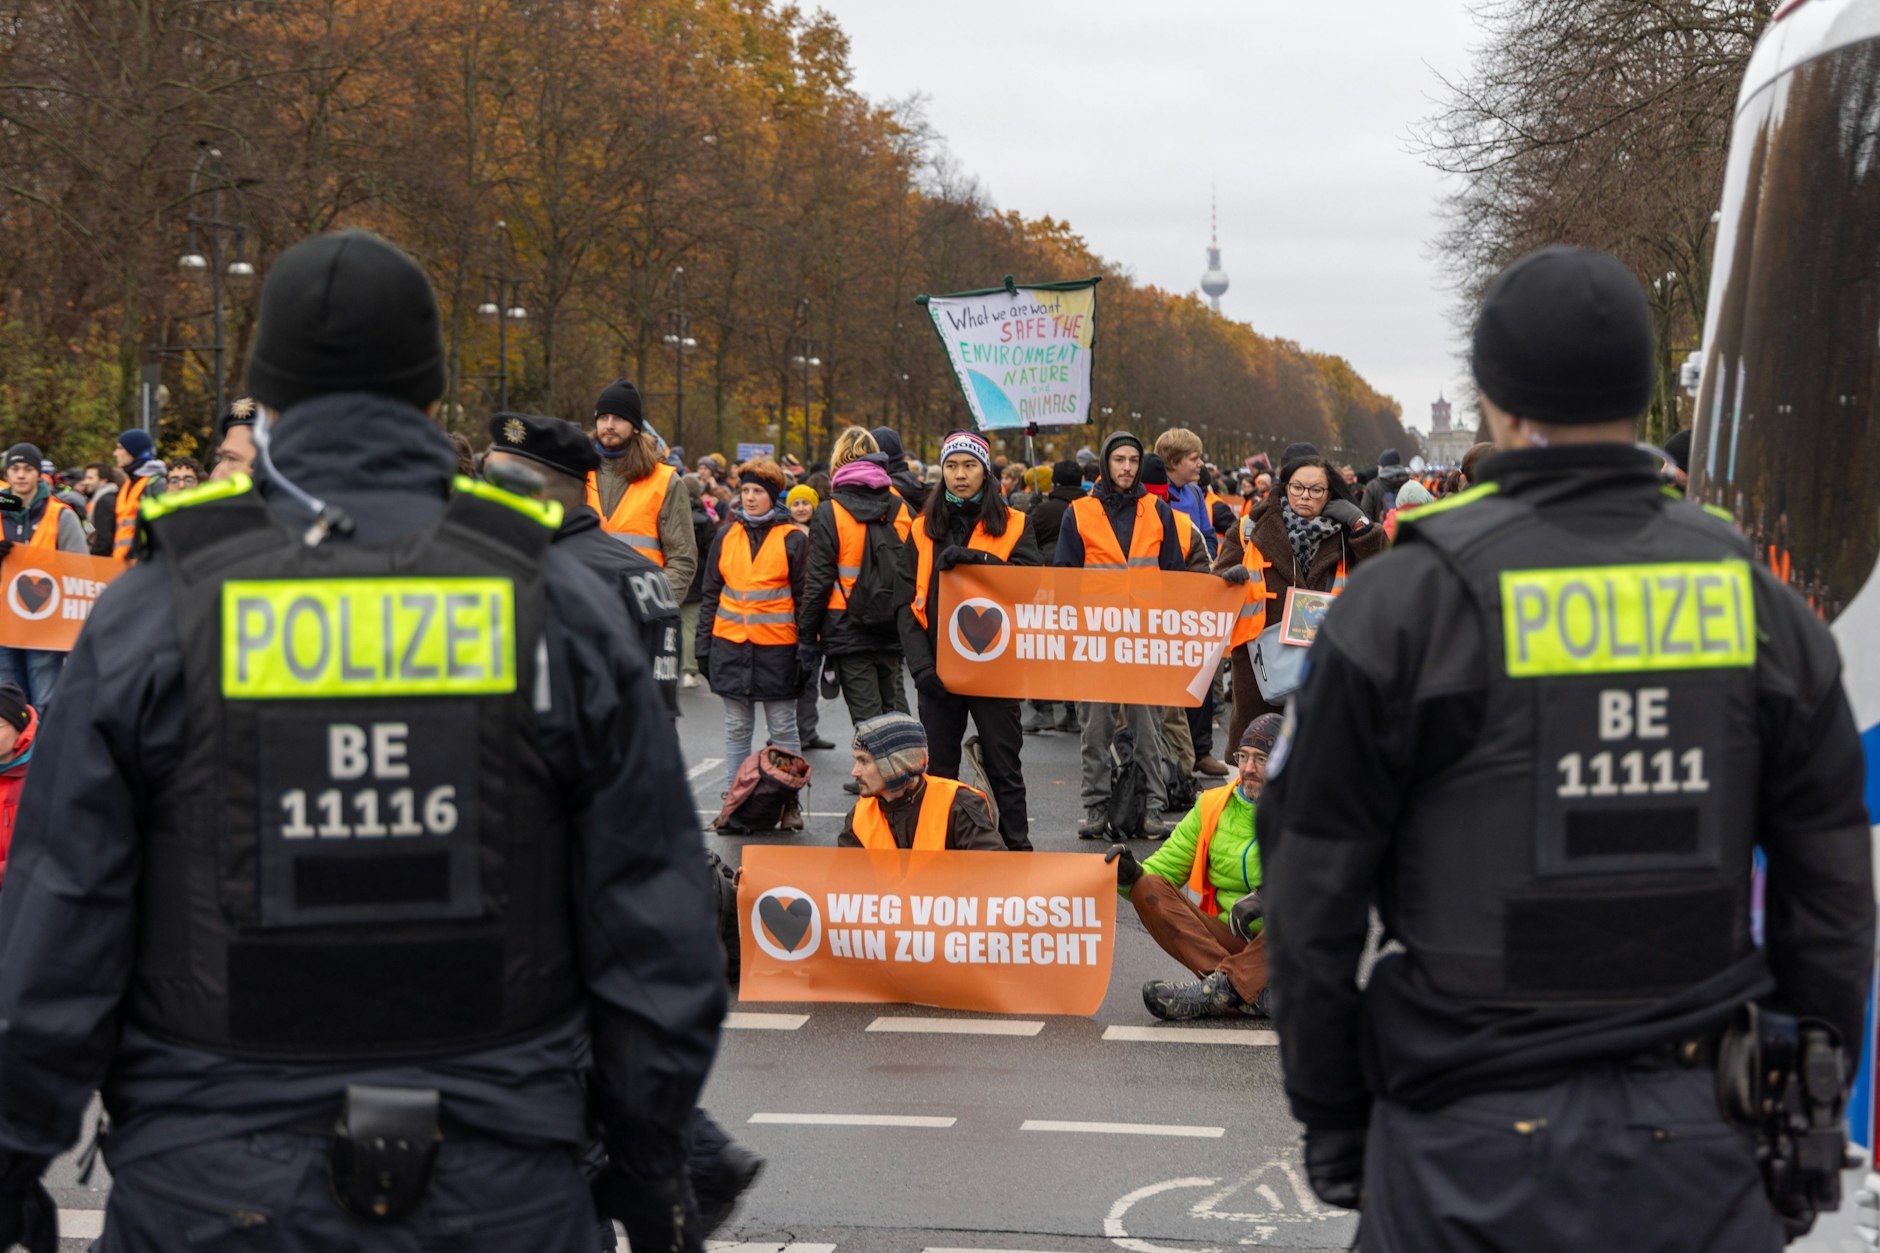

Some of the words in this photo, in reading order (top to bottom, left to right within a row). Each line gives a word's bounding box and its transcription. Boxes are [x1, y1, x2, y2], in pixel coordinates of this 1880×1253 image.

[947, 305, 989, 331] What
[992, 309, 1006, 322] we
[1010, 305, 1028, 318] are
[1032, 296, 1062, 315] want
[1000, 317, 1046, 343] SAFE
[1053, 314, 1085, 339] THE
[959, 341, 1080, 366] ENVIRONMENT
[1003, 365, 1069, 385] NATURE
[1032, 383, 1050, 394] and
[1019, 393, 1077, 419] ANIMALS
[1015, 603, 1077, 631] WEG
[1083, 606, 1141, 633] VON
[1512, 574, 1746, 663] POLIZEI
[235, 593, 503, 684] POLIZEI
[1015, 633, 1065, 661] HIN
[1072, 636, 1106, 662] ZU
[1114, 638, 1220, 668] GERECH
[1599, 687, 1669, 741] BE
[328, 722, 410, 780] BE
[1557, 747, 1709, 798] 11111
[280, 785, 458, 838] 11116
[827, 893, 901, 925] WEG
[910, 895, 977, 926] VON
[986, 896, 1102, 928] FOSSIL
[827, 929, 887, 961] HIN
[894, 930, 935, 963] ZU
[944, 931, 1102, 966] GERECHT
